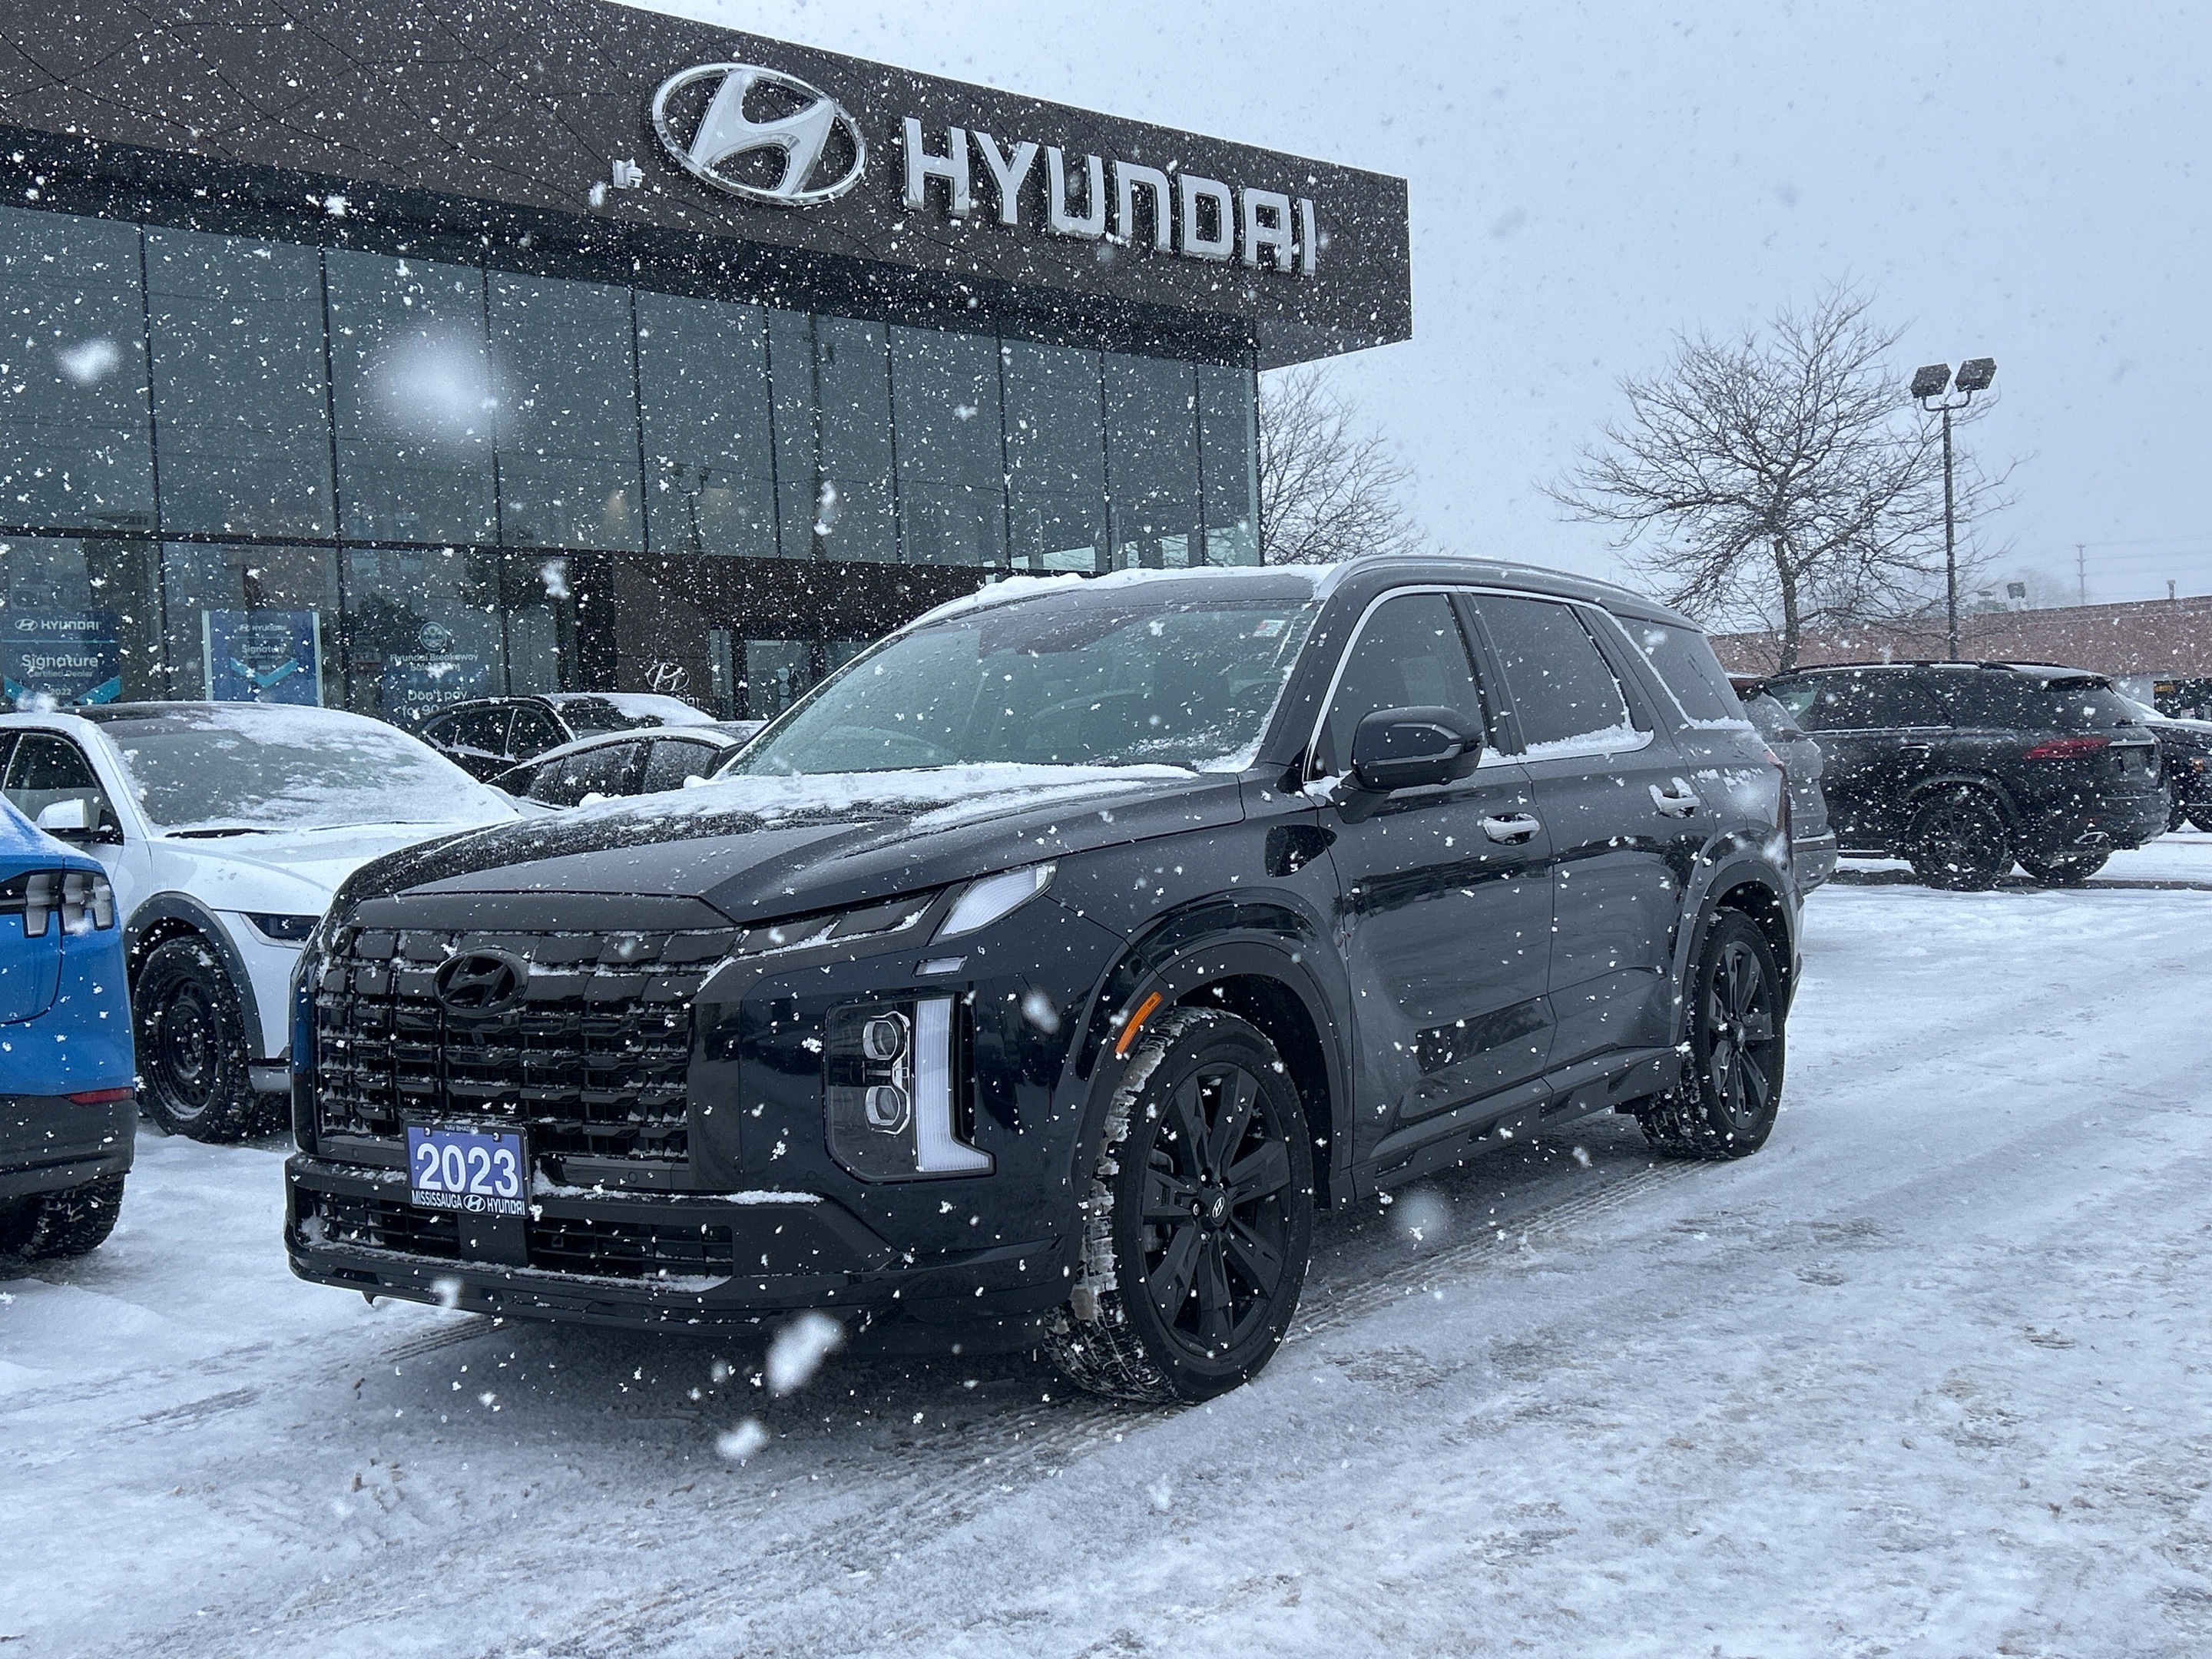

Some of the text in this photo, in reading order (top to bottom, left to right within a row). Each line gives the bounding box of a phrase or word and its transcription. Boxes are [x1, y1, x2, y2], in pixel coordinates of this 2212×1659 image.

[902, 116, 1316, 276] HYUNDAI
[41, 620, 99, 631] HYUNDAI
[22, 654, 98, 670] Signature
[408, 689, 468, 702] Don't pay
[417, 1143, 518, 1197] 2023
[411, 1190, 526, 1216] MISSISSAUGA HYUNDAI
